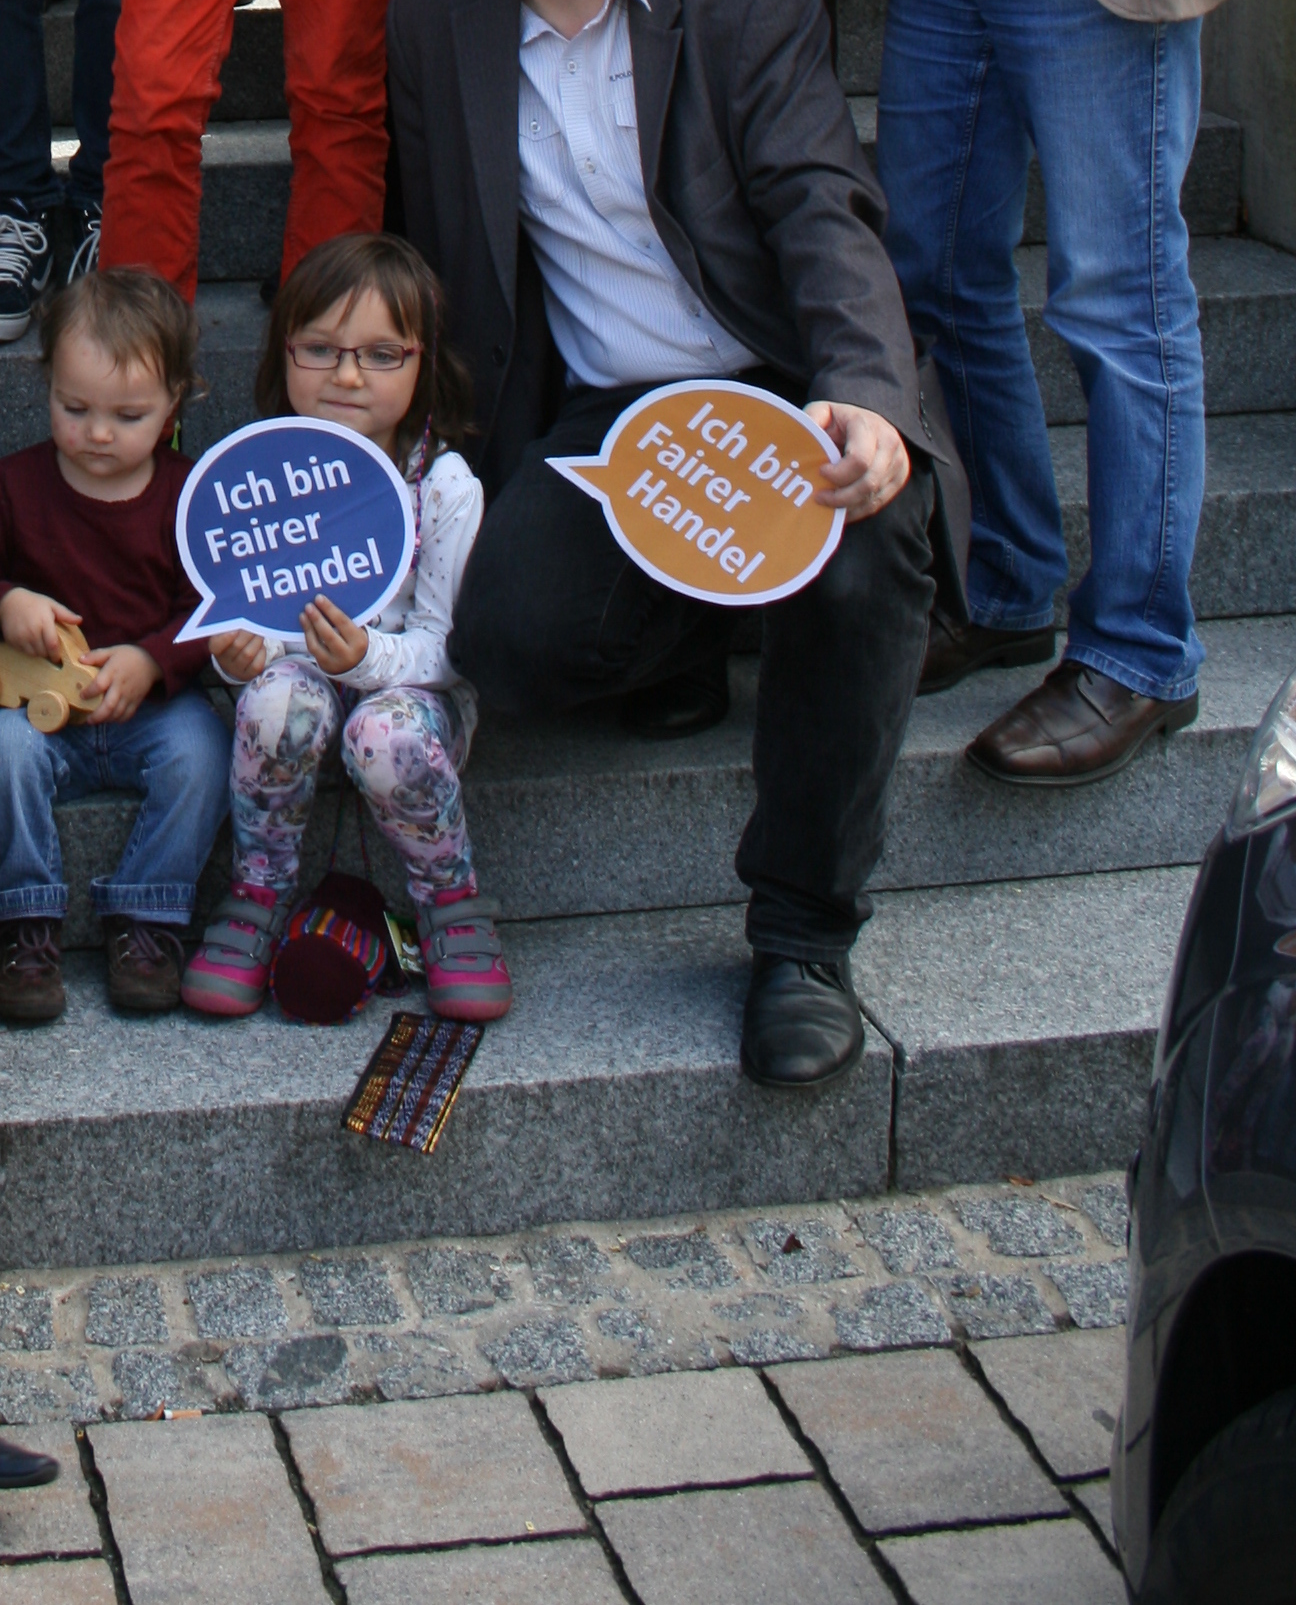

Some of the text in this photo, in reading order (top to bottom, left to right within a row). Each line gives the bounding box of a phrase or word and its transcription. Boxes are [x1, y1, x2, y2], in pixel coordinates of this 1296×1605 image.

[213, 455, 351, 515] Ich bin
[636, 421, 752, 513] Fairer
[686, 401, 814, 508] Ich bin
[204, 511, 321, 564] Fairer
[626, 469, 766, 585] Handel
[240, 537, 384, 603] Handel
